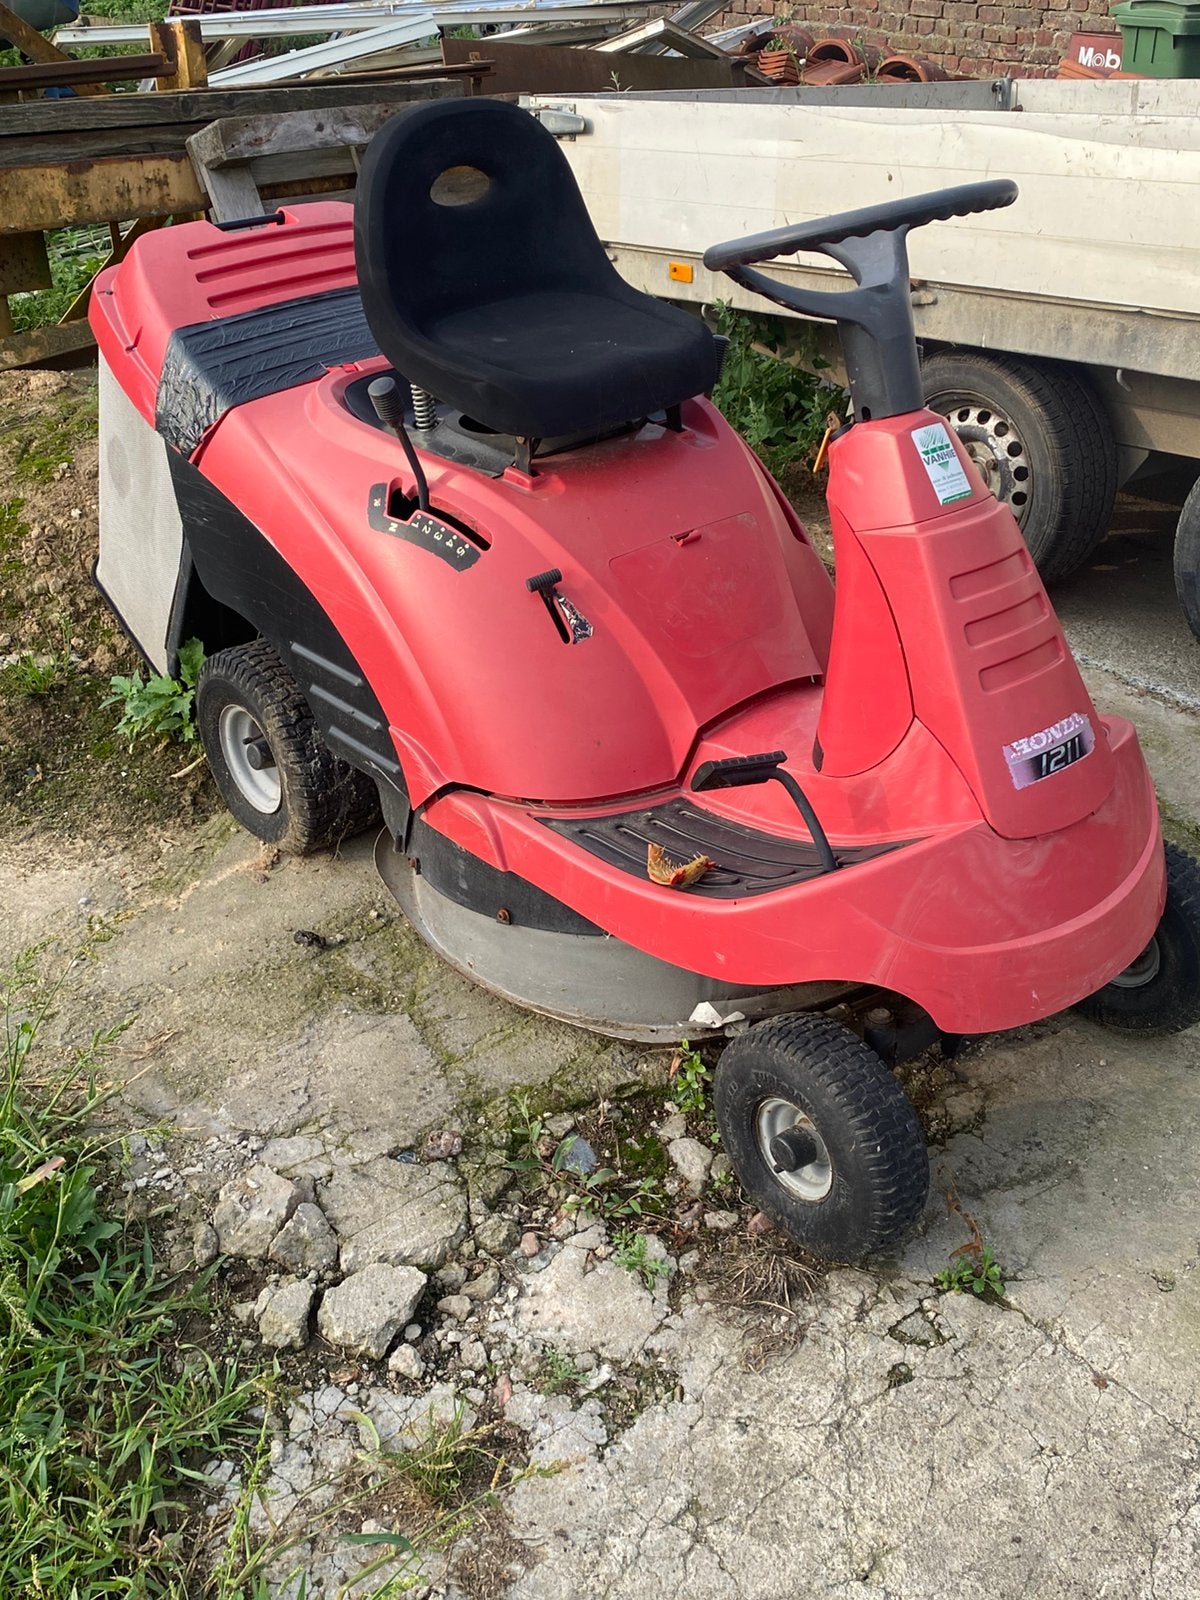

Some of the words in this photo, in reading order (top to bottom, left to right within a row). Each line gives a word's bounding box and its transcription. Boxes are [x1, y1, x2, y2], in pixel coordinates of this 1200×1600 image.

[1078, 46, 1122, 70] Mob
[422, 525, 431, 534] 2
[433, 531, 442, 541] 3
[445, 539, 453, 548] 4
[456, 546, 465, 556] 5
[1041, 736, 1080, 776] 1211
